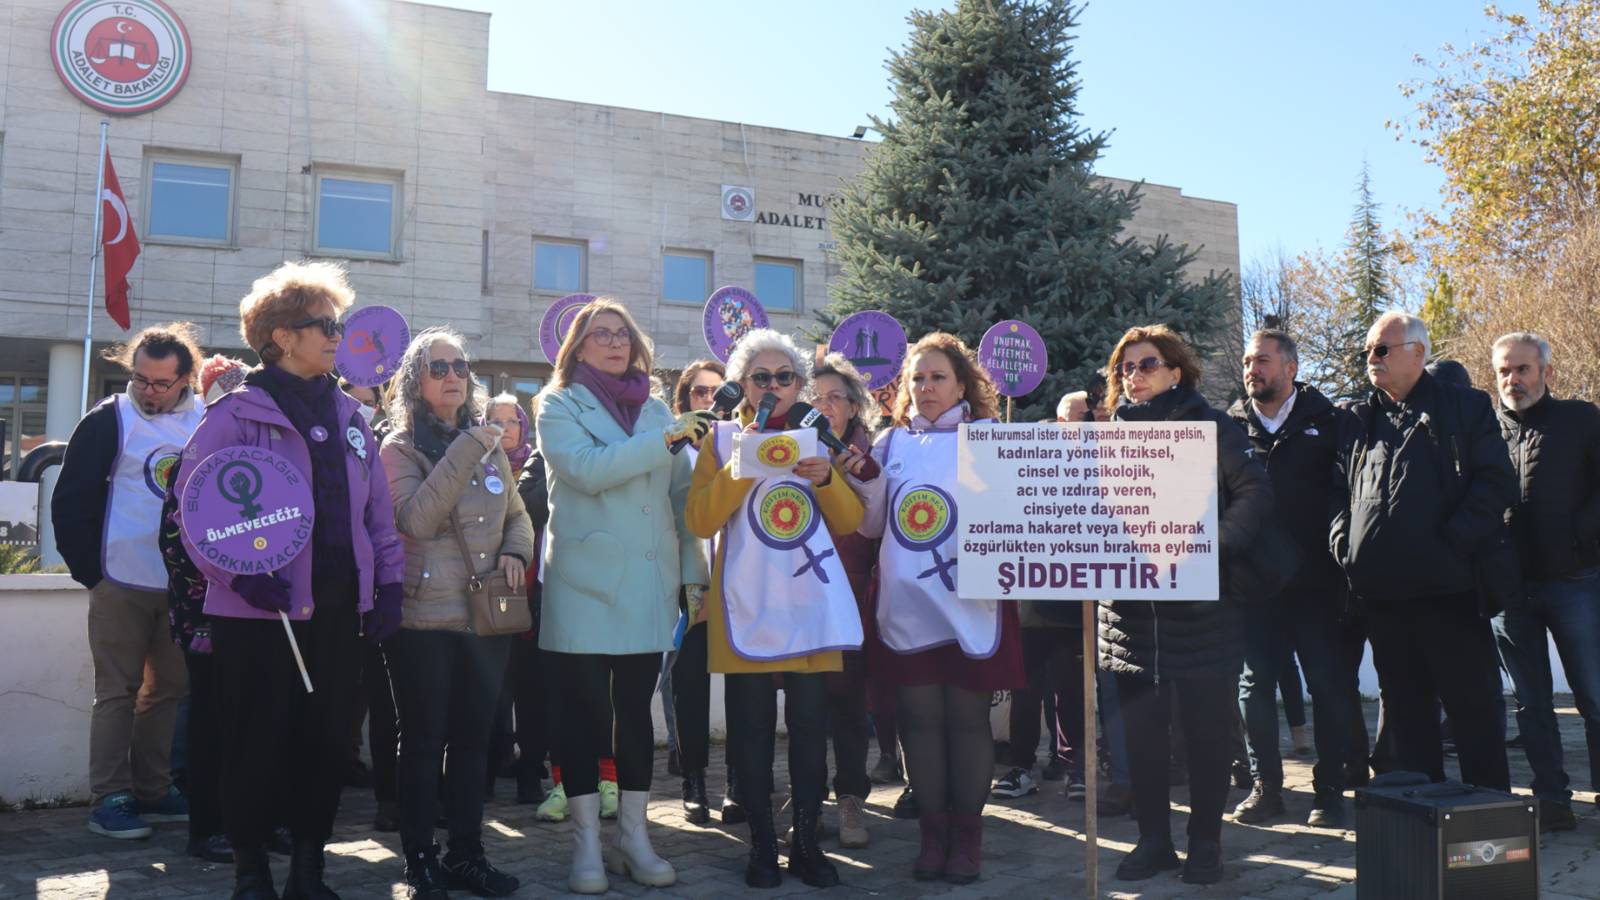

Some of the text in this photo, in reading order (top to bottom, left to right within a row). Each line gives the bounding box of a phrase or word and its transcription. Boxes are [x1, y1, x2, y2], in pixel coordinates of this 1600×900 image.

[113, 5, 136, 17] T.C.
[72, 50, 111, 90] ADALET
[755, 211, 826, 230] ADALET
[993, 335, 1033, 350] UNUTMAK,
[993, 347, 1033, 361] AFFETMEK,
[986, 357, 1039, 373] HELALLEŞMEK
[1004, 373, 1020, 382] YOK
[967, 427, 1206, 443] İster kurumsal ister özel yaşamda meydana gelsin,
[997, 446, 1174, 462] kadınlara yönelik fiziksel,
[1018, 465, 1155, 480] cinsel ve psikolojik,
[188, 450, 300, 513] SUSMAYACAĞIZ
[1016, 483, 1157, 499] acı ve ızdırap veren,
[1023, 502, 1150, 518] cinsiyete dayanan
[206, 506, 301, 542] ÖLMEYECEĞİZ
[968, 521, 1205, 537] zorlama hakaret veya keyfi olarak
[197, 514, 313, 573] KORKMAYACAĞIZ
[963, 540, 1212, 556] özgürlükten yoksun bırakma eylemi
[998, 556, 1177, 594] ŞİDDETTİR !
